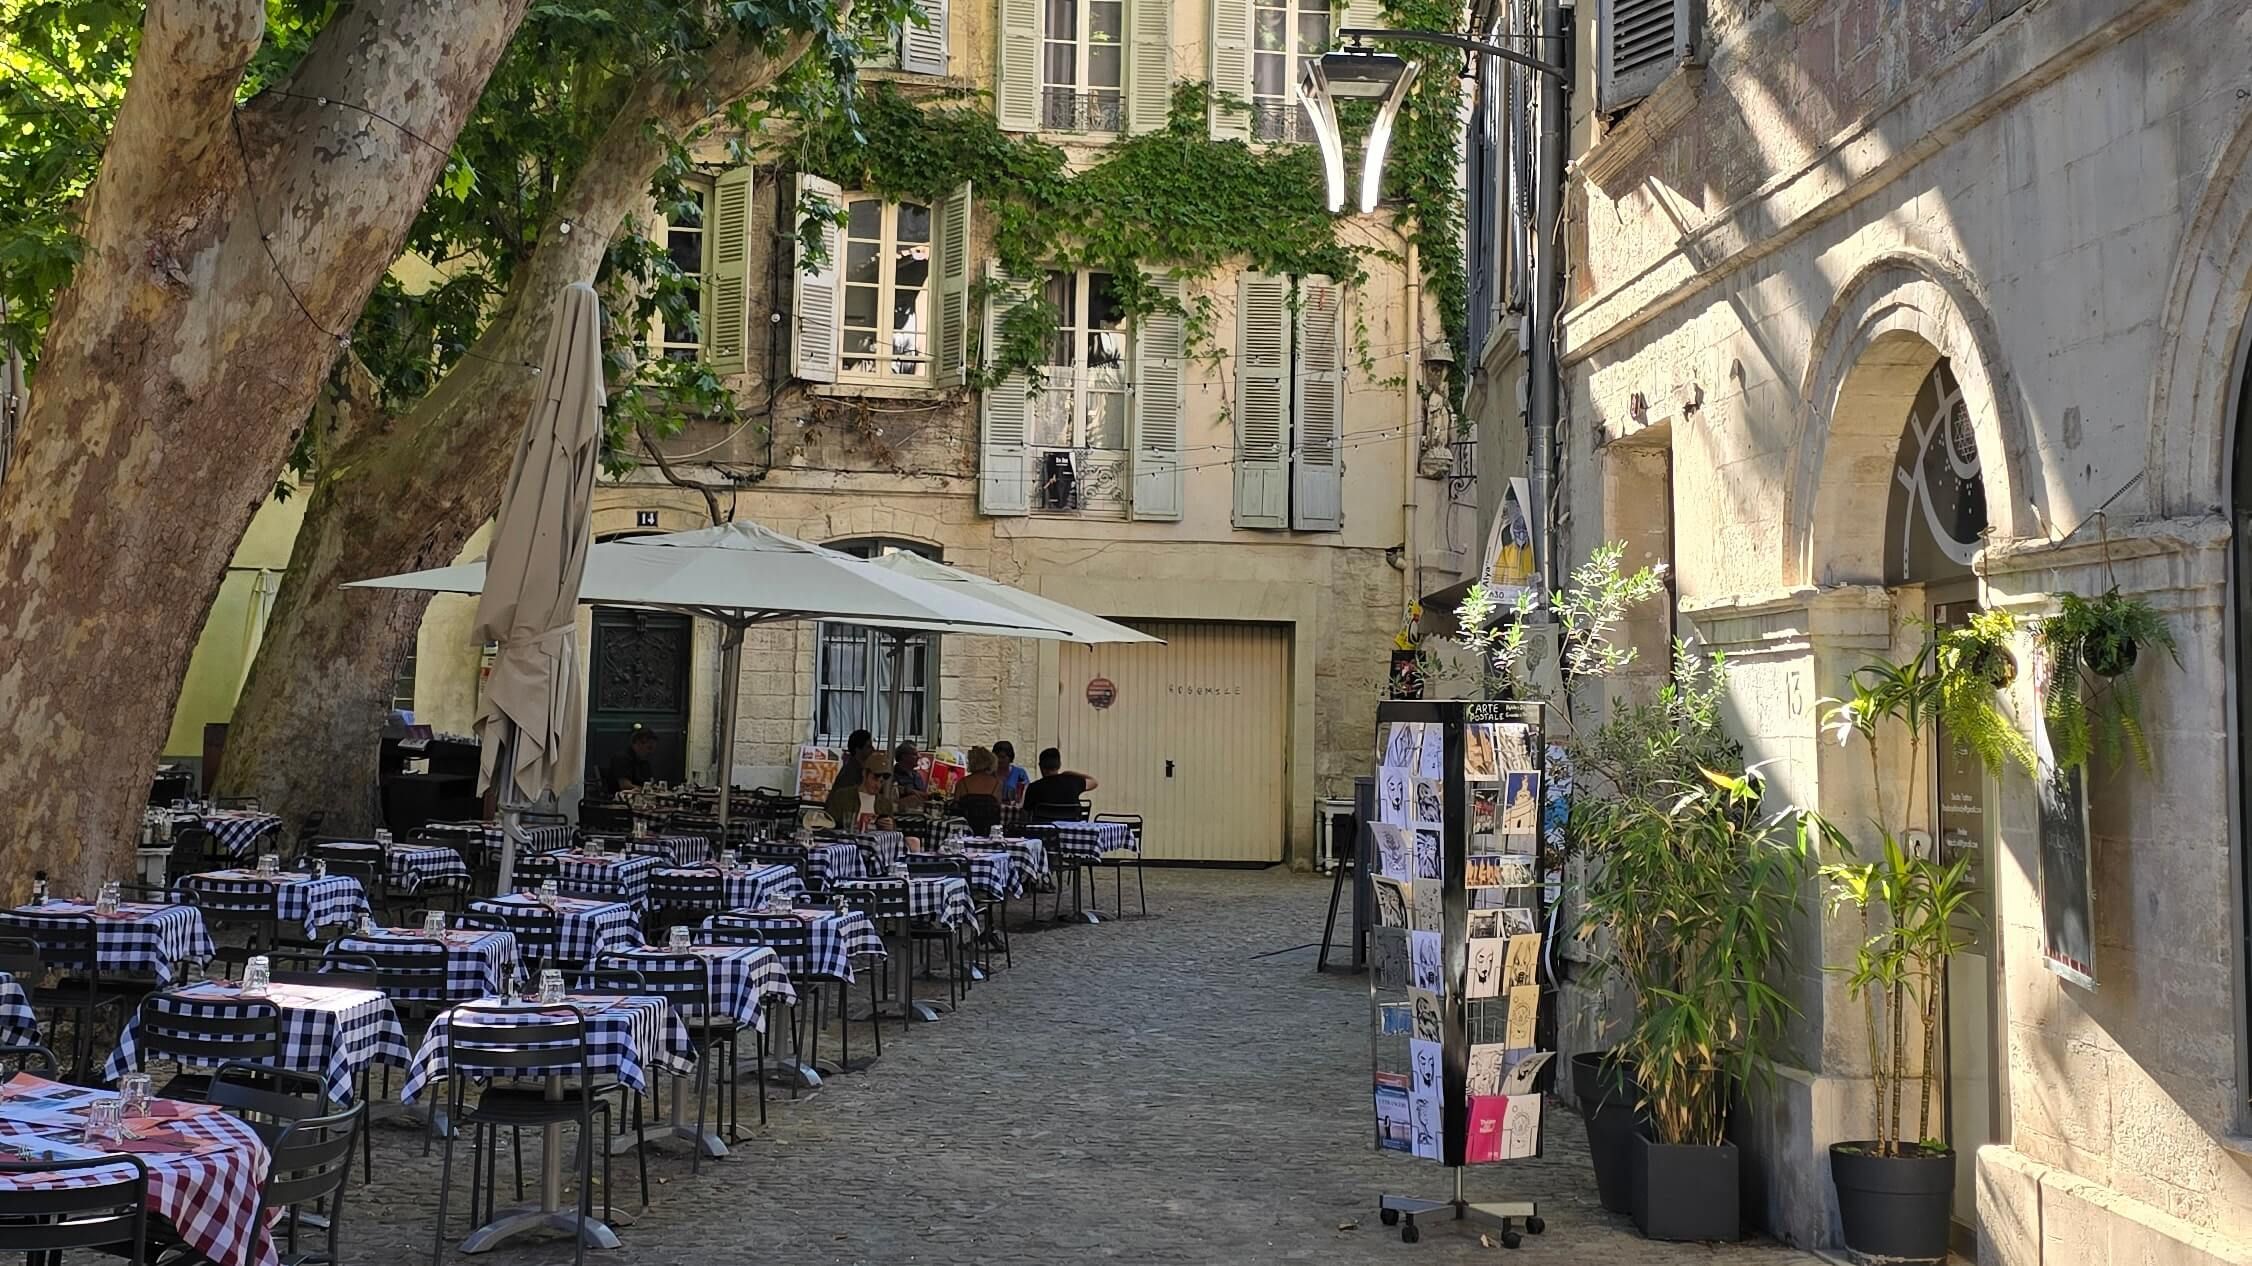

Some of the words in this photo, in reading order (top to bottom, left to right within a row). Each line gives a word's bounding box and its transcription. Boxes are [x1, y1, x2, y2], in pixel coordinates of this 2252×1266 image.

[642, 512, 655, 525] 14
[1786, 671, 1803, 720] 13
[1468, 703, 1499, 714] CARTE
[1470, 712, 1504, 722] POSTALE
